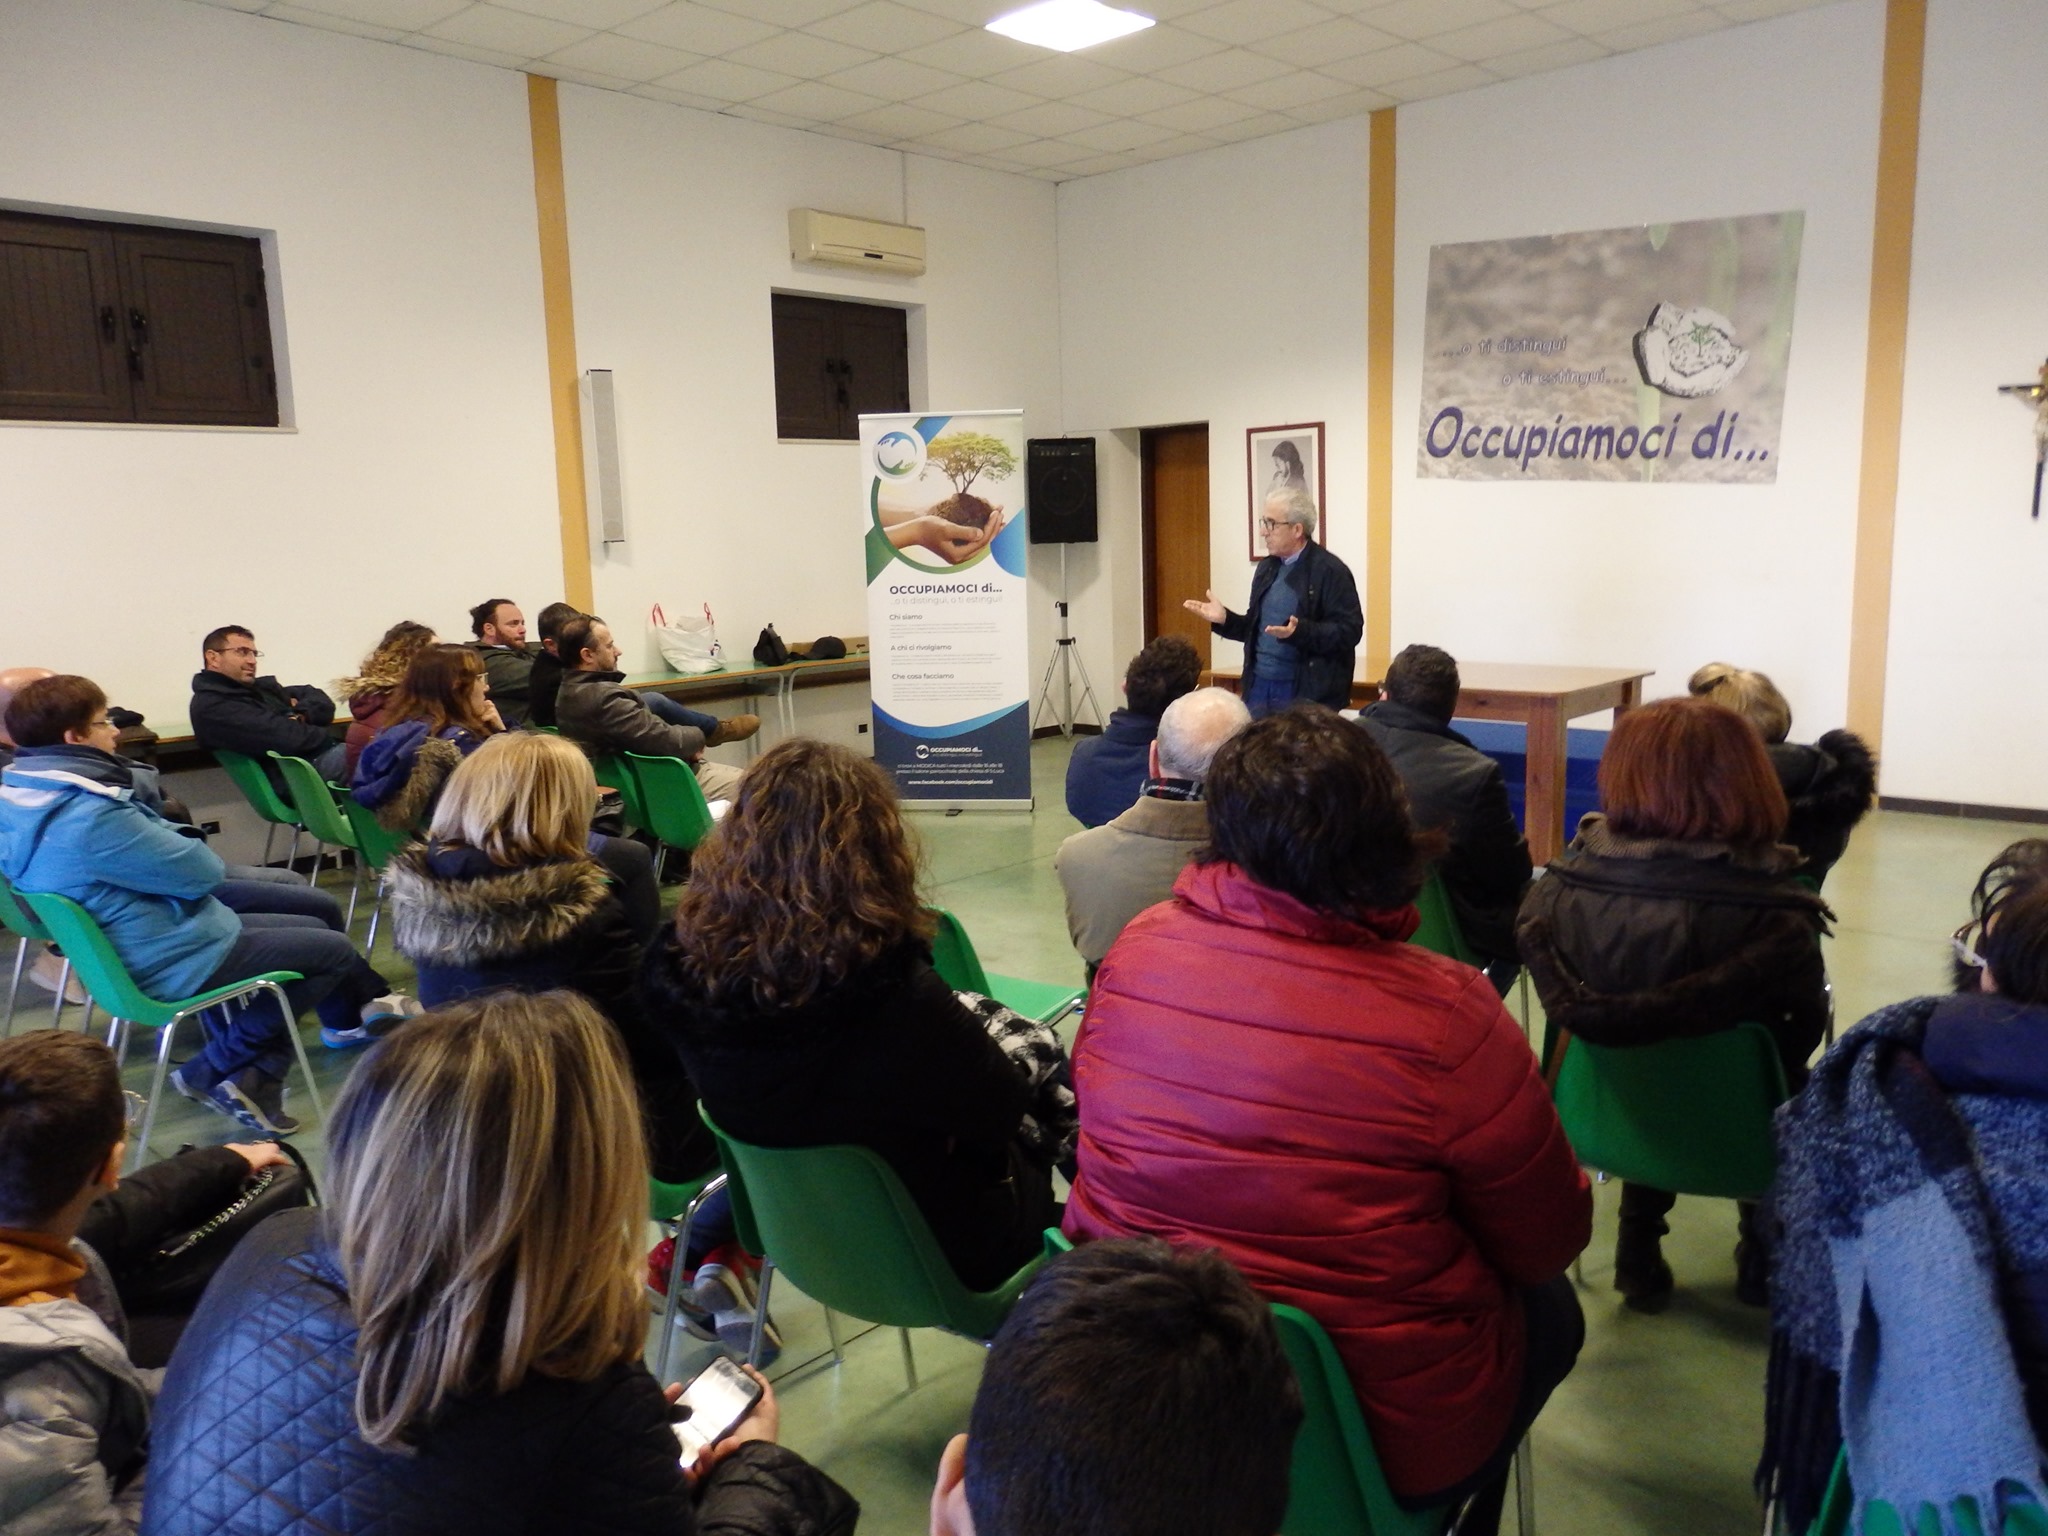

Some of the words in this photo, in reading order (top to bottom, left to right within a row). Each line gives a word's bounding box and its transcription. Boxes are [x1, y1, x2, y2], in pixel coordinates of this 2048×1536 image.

[1479, 338, 1492, 355] ti
[1497, 335, 1568, 357] distingui
[1501, 374, 1512, 386] o
[1519, 369, 1532, 385] ti
[1538, 367, 1628, 388] estingui...
[1425, 406, 1683, 472] Occupiamoci
[1691, 409, 1770, 462] di...
[889, 584, 978, 595] OCCUPIAMOCI
[981, 582, 1003, 593] di...
[916, 644, 952, 652] rivolgiamo
